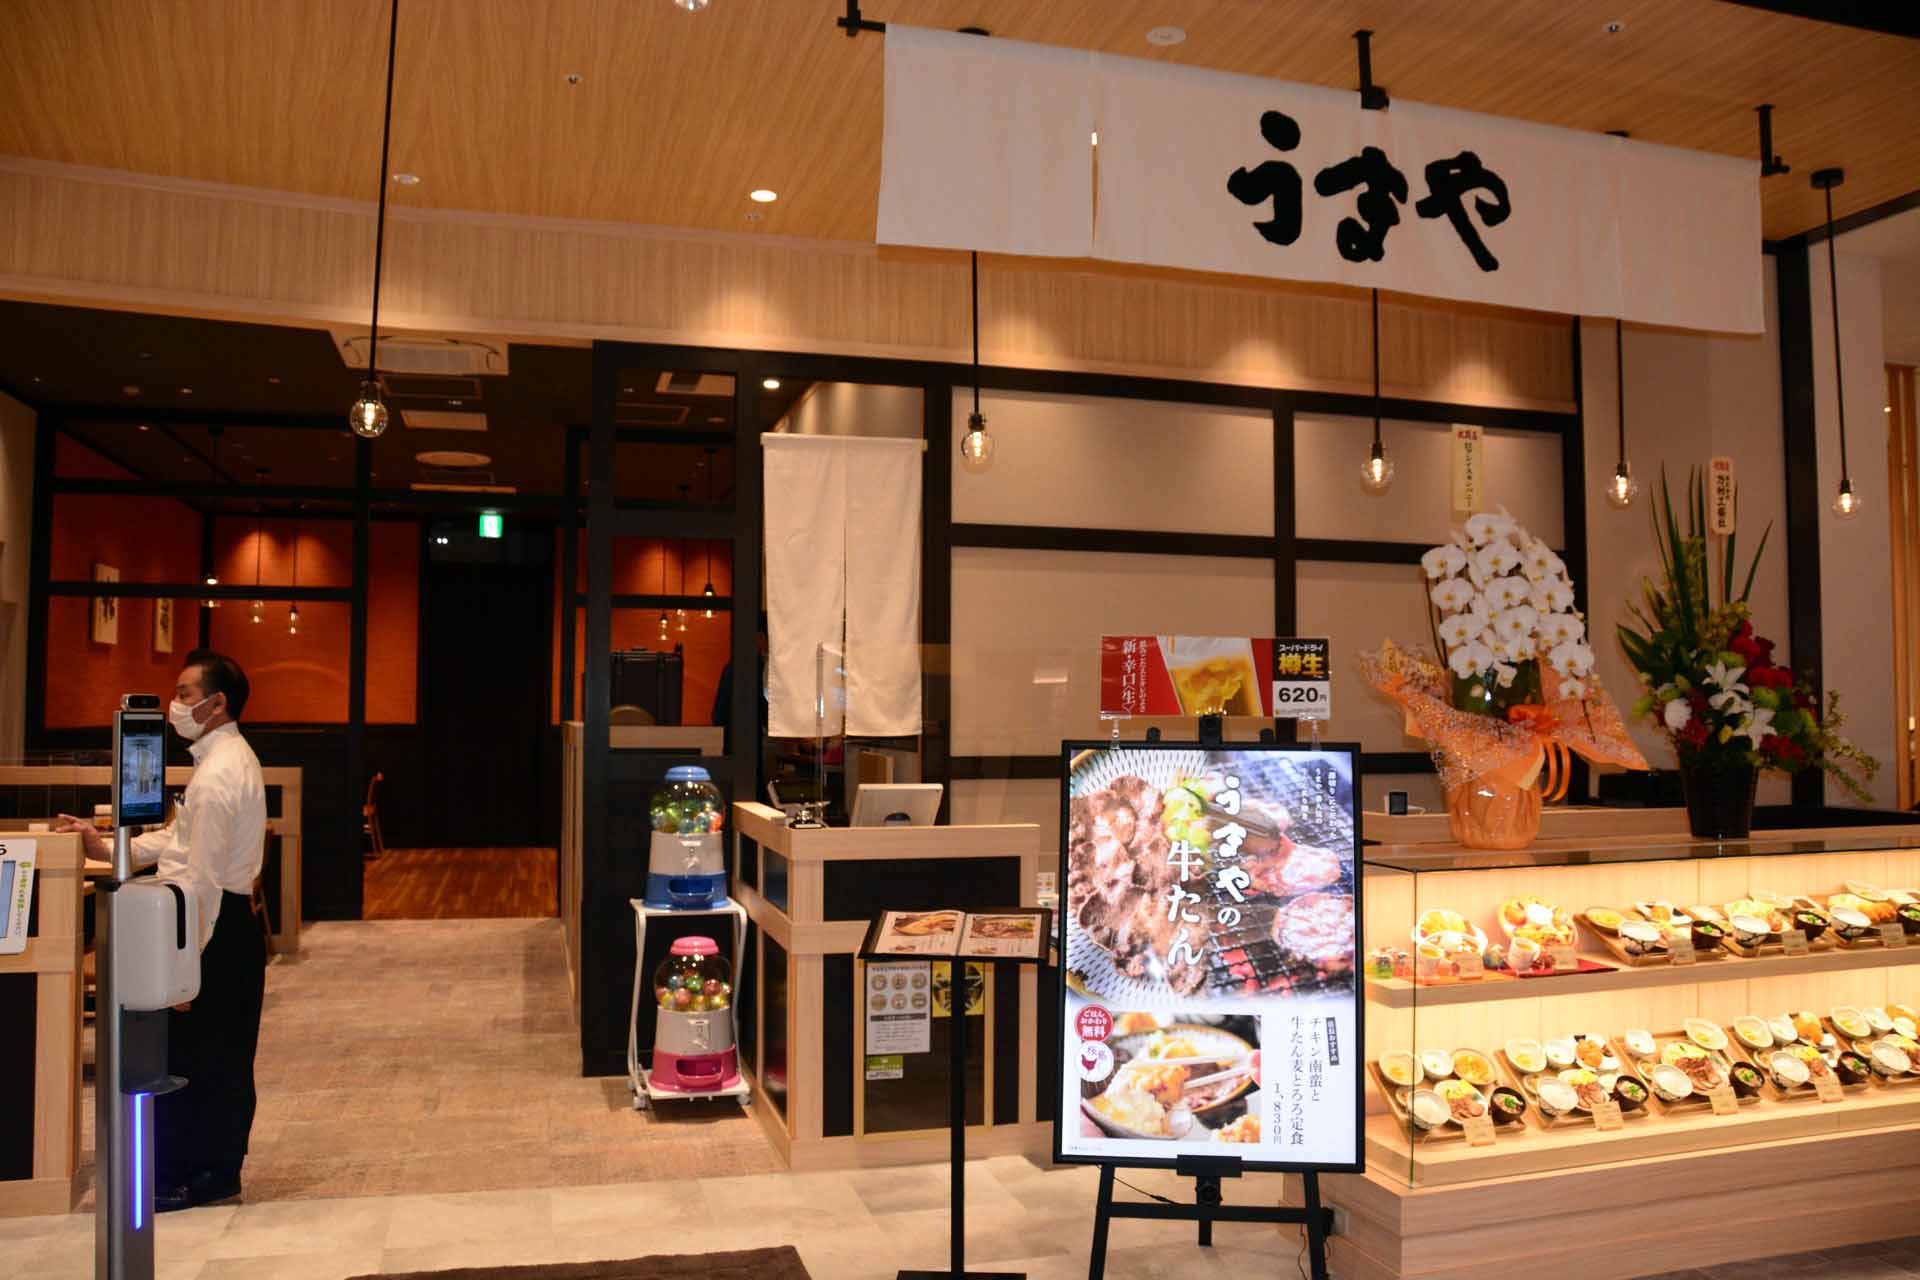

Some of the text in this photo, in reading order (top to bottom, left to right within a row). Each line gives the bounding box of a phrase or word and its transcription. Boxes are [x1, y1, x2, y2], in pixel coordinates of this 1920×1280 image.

[1226, 110, 1512, 273] うまや
[1278, 653, 1325, 677] 樽生
[1278, 687, 1328, 703] 620円
[1166, 839, 1205, 967] 牛たん
[1211, 776, 1251, 927] うまやの
[1081, 1025, 1106, 1038] 無料
[1290, 1016, 1304, 1145] 牛たん麦とろろ定食
[1309, 1017, 1322, 1102] チキン南蛮と
